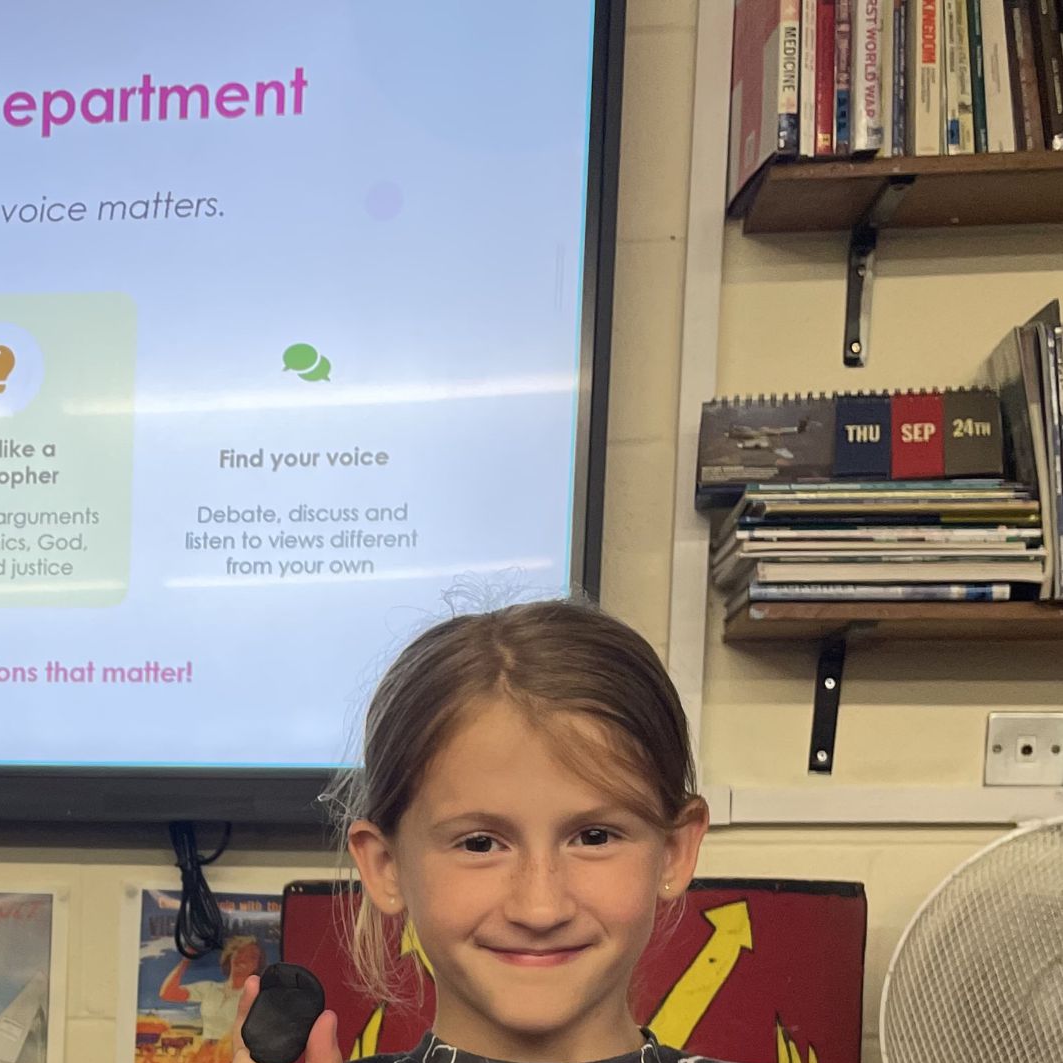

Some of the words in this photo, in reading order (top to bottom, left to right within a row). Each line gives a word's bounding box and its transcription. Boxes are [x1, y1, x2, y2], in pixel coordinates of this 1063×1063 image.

[782, 26, 797, 92] MEDICINE
[864, 29, 878, 81] WORLD
[1, 194, 88, 225] voice
[97, 192, 226, 222] matters.
[844, 424, 882, 443] THU
[900, 422, 937, 443] SEP
[951, 418, 993, 438] 24TH
[41, 443, 57, 458] a
[219, 447, 266, 469] Find
[270, 453, 320, 474] your
[326, 447, 390, 468] voice
[197, 505, 283, 527] Debate,
[288, 503, 360, 524] discuss
[364, 503, 409, 523] and
[37, 533, 90, 556] God,
[185, 531, 237, 551] listen
[241, 531, 262, 551] to
[268, 532, 325, 550] views
[330, 528, 419, 549] different
[9, 556, 74, 580] justice
[225, 556, 273, 576] from
[277, 560, 325, 579] your
[330, 559, 375, 575] own
[46, 661, 96, 683] that
[102, 661, 194, 684] matter!
